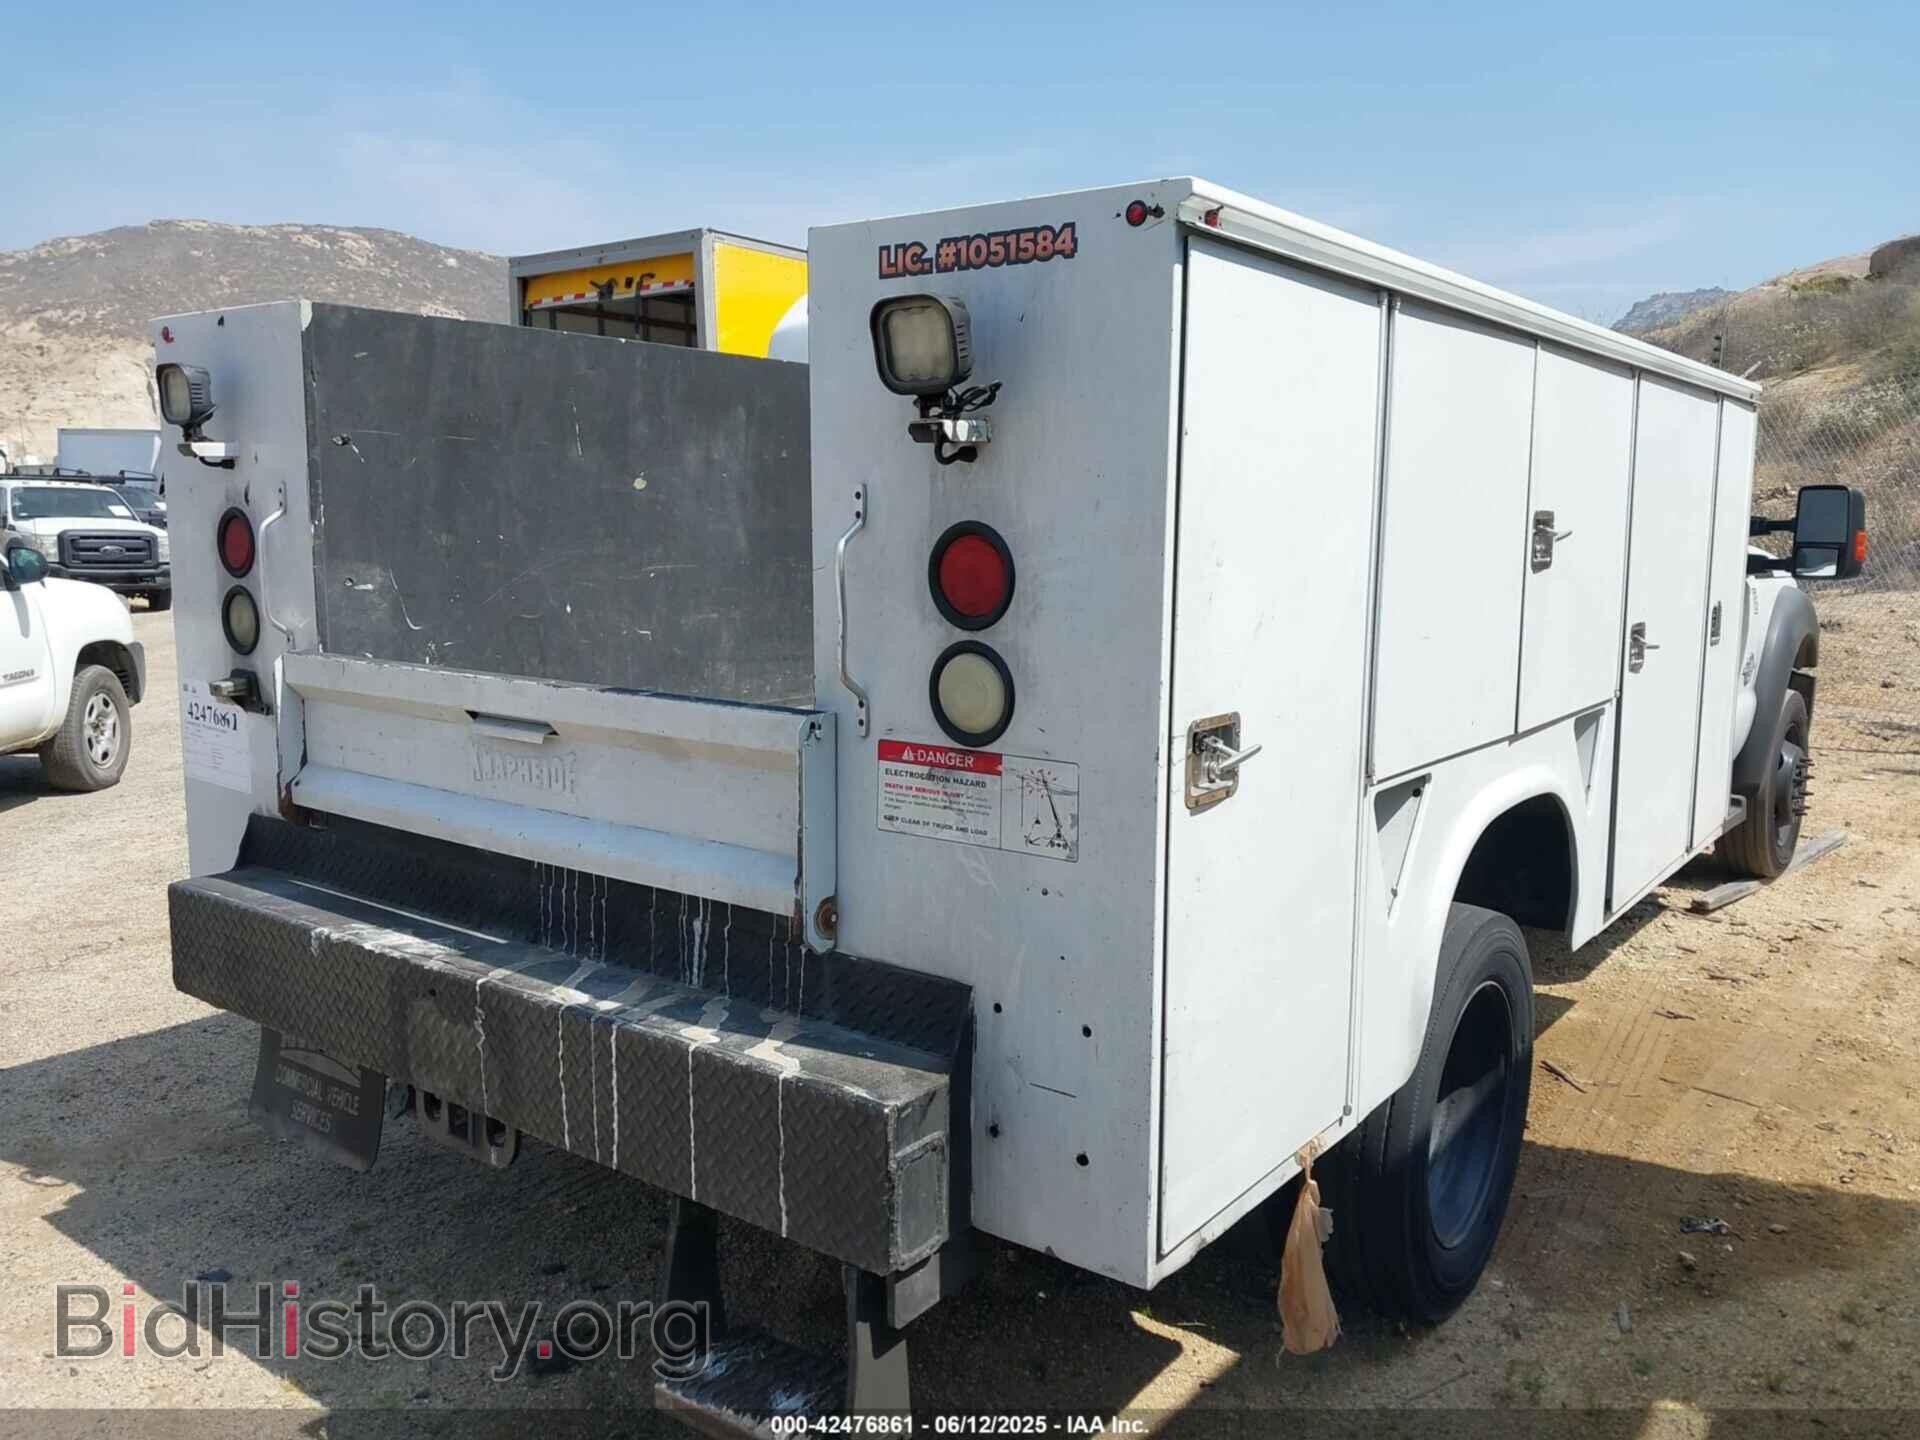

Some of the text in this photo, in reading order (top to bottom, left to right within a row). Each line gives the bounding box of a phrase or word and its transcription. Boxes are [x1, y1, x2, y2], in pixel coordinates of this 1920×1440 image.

[879, 222, 1078, 279] LIC. #1051584
[187, 701, 238, 731] 42476861
[917, 749, 975, 767] DANGER
[953, 776, 987, 789] HAZARD
